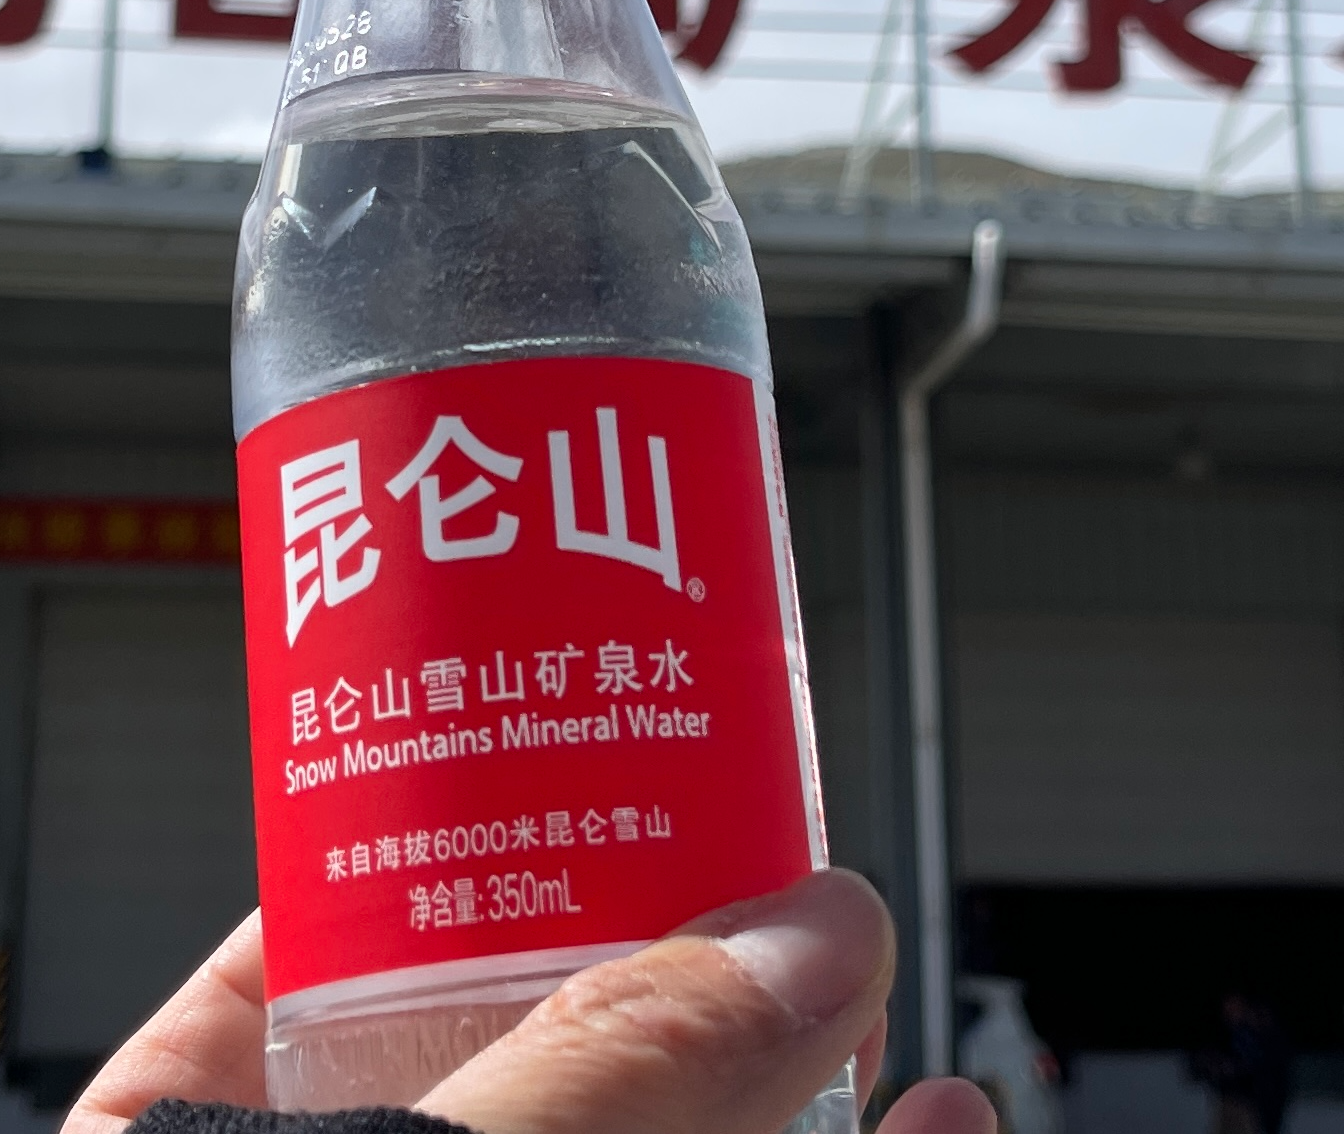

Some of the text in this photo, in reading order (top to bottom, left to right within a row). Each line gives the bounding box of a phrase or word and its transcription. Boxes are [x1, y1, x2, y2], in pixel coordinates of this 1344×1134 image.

[279, 407, 683, 649] 昆仑山
[290, 639, 694, 747] 昆仑山雪山矿泉水
[285, 703, 711, 795] Snow Mountains Mineral Water
[325, 805, 672, 882] 来自海拔6000米昆仑雪山
[408, 868, 582, 932] 净含量:350mL
